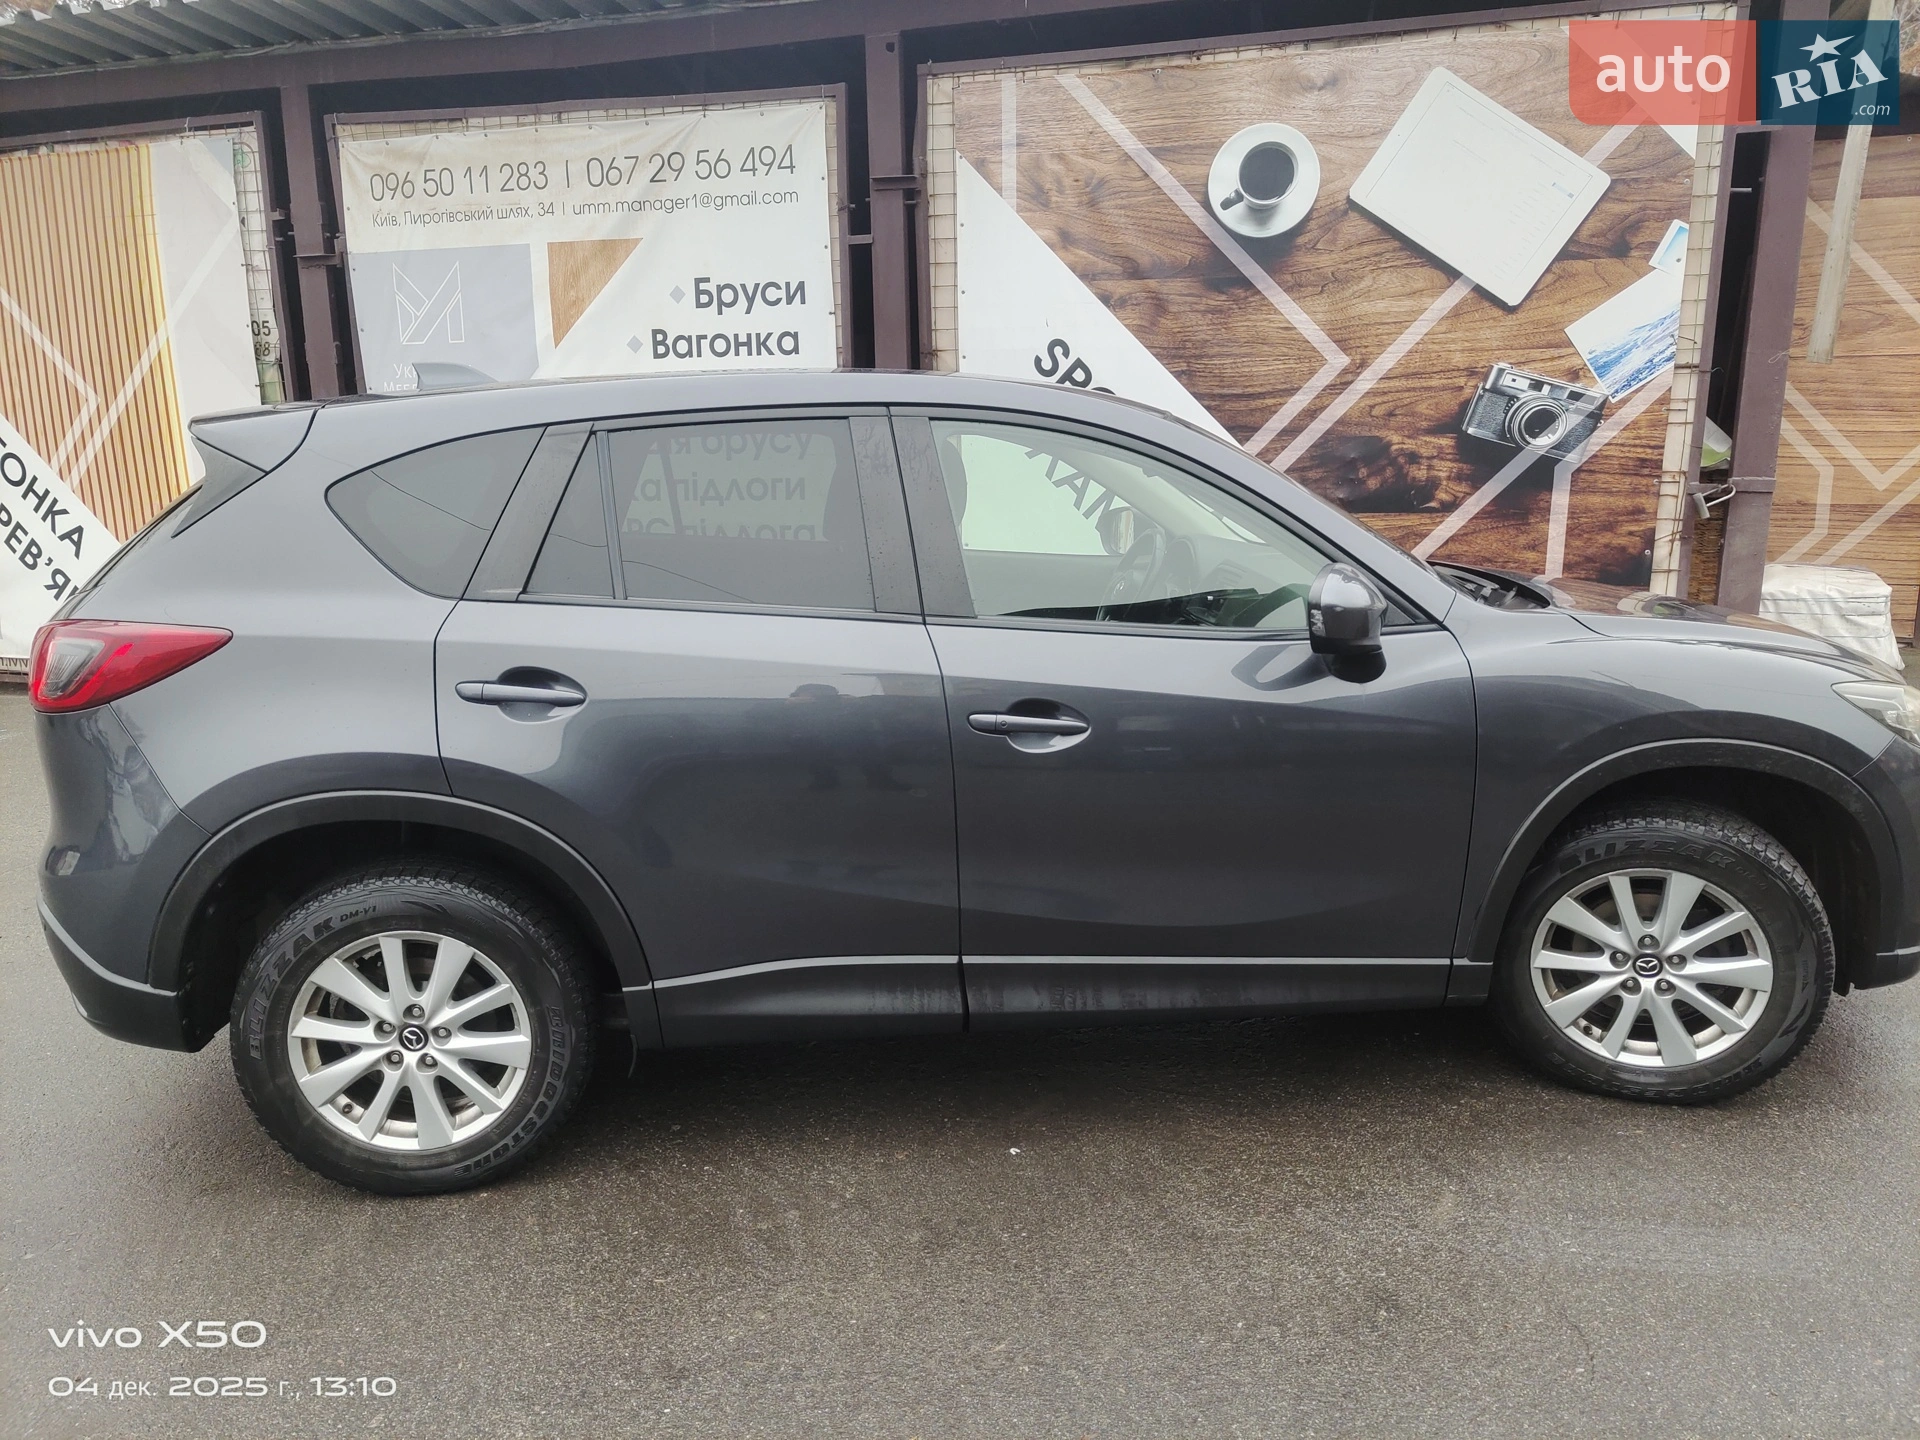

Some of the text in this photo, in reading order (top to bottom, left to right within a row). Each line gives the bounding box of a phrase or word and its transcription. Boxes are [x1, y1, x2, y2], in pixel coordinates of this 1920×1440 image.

[370, 171, 415, 201] 096
[423, 167, 455, 198] 50
[463, 164, 490, 195] 11
[499, 160, 549, 192] 283
[586, 155, 640, 187] 067
[648, 151, 686, 183] 29
[694, 148, 732, 180] 56
[739, 144, 796, 177] 494
[372, 212, 401, 228] Київ,
[404, 206, 494, 228] Пирогівський
[497, 205, 534, 220] шлях,
[537, 202, 555, 217] 34
[572, 190, 799, 216] umm.manager1@gmail.com
[693, 276, 807, 316] Бруси
[651, 328, 801, 359] Вагонка
[1033, 338, 1117, 395] SP
[0, 437, 85, 560] ОНКА
[249, 904, 378, 1060] BLIZZAK DM-V1
